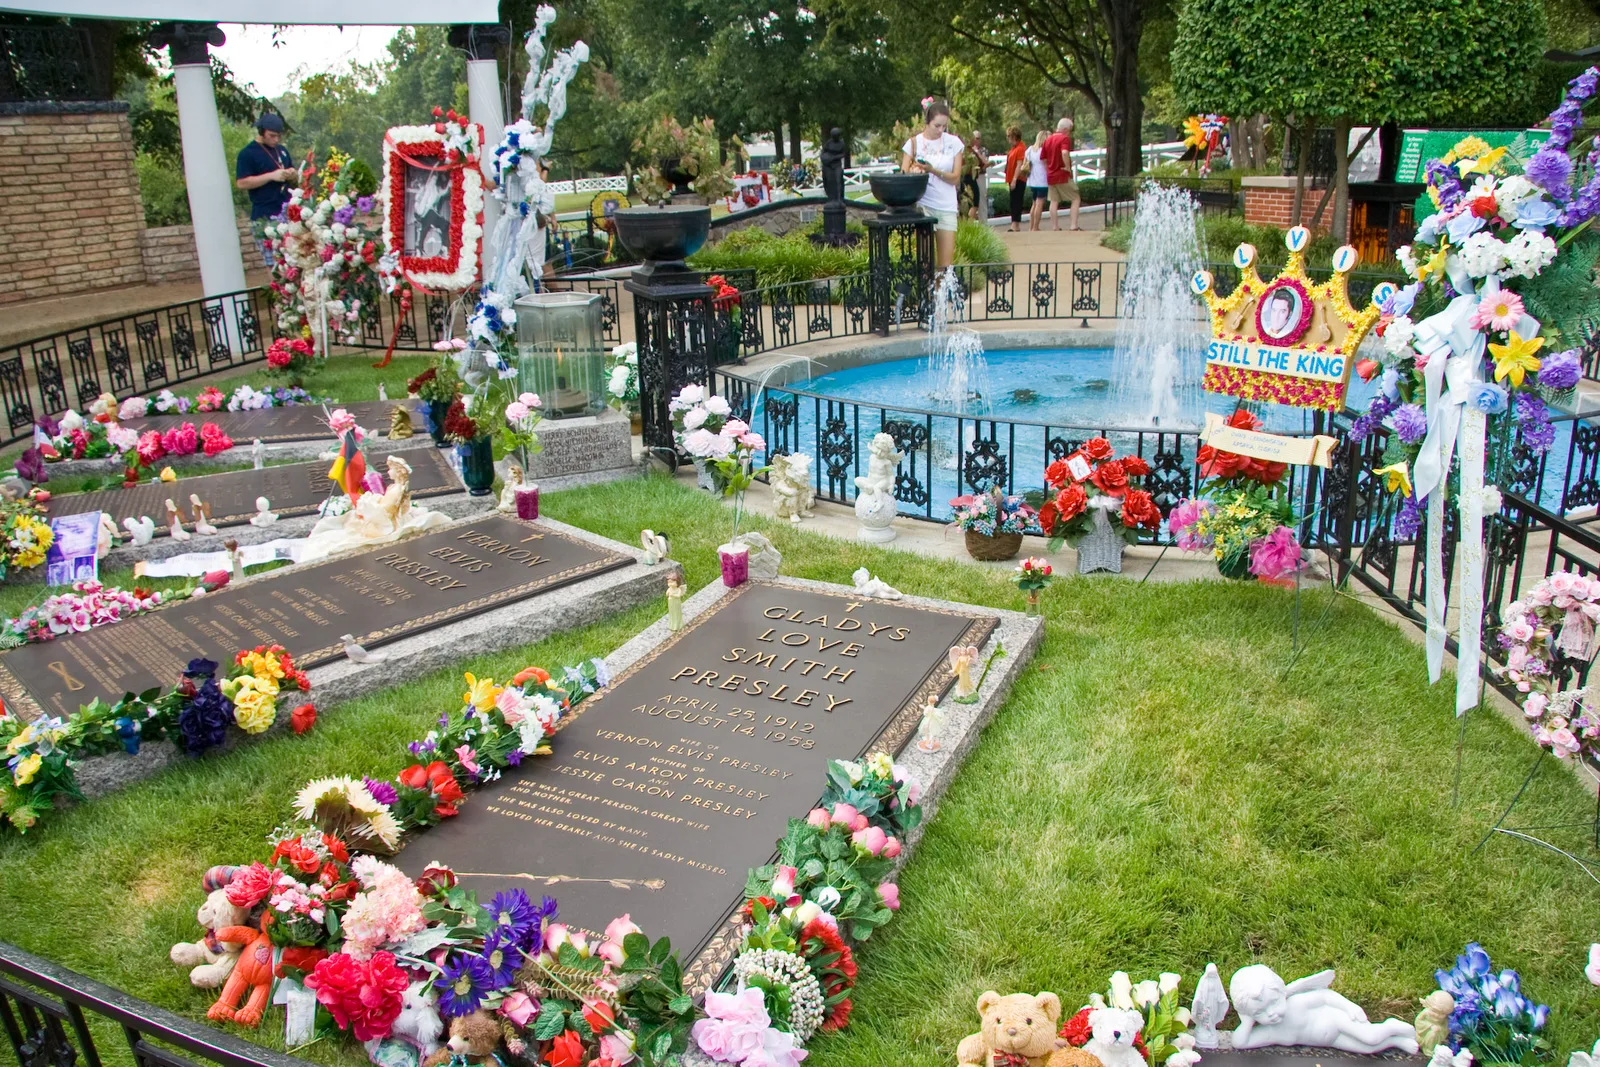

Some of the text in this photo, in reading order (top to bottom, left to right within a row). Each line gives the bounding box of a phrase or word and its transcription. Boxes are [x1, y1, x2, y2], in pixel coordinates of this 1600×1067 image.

[1257, 349, 1290, 370] THE
[427, 546, 493, 573] ELVIS
[457, 530, 551, 568] VERNON
[375, 552, 467, 592] PRESLEY
[389, 586, 416, 600] 1916
[763, 606, 911, 641] GLADYS
[756, 628, 865, 658] LOVE
[721, 647, 856, 684] SMITH
[670, 666, 853, 713] PRESLEY
[631, 704, 816, 750] AUGUST 14, 1958
[657, 694, 815, 734] APRIL 25, 1912
[596, 729, 794, 780] VERNON ELVIS PRESLEY
[680, 737, 702, 747] WIFE
[573, 750, 770, 801] ELVIS AARON PRESLEY
[649, 756, 687, 769] MOTHER
[510, 786, 573, 805] AND MOTHER.
[551, 765, 606, 782] JESSIE
[680, 794, 757, 819] PRESLEY
[647, 778, 670, 787] AND
[498, 795, 516, 804] SHE
[518, 800, 538, 809] WAS
[539, 805, 565, 815] ALSO
[566, 812, 600, 824] LOVED
[602, 821, 617, 829] BY
[518, 780, 536, 788] SHE
[539, 784, 558, 792] WAS
[568, 791, 600, 802] GREAT
[651, 811, 683, 824] GREAT
[686, 820, 711, 831] WIFE
[486, 805, 500, 813] WE
[501, 809, 533, 821] LOVED
[534, 818, 554, 827] HER
[555, 823, 593, 837] DEARLY
[593, 834, 616, 843] AND
[618, 840, 637, 849] SHE
[651, 849, 684, 863] SADLY
[579, 927, 611, 941] VERNO
